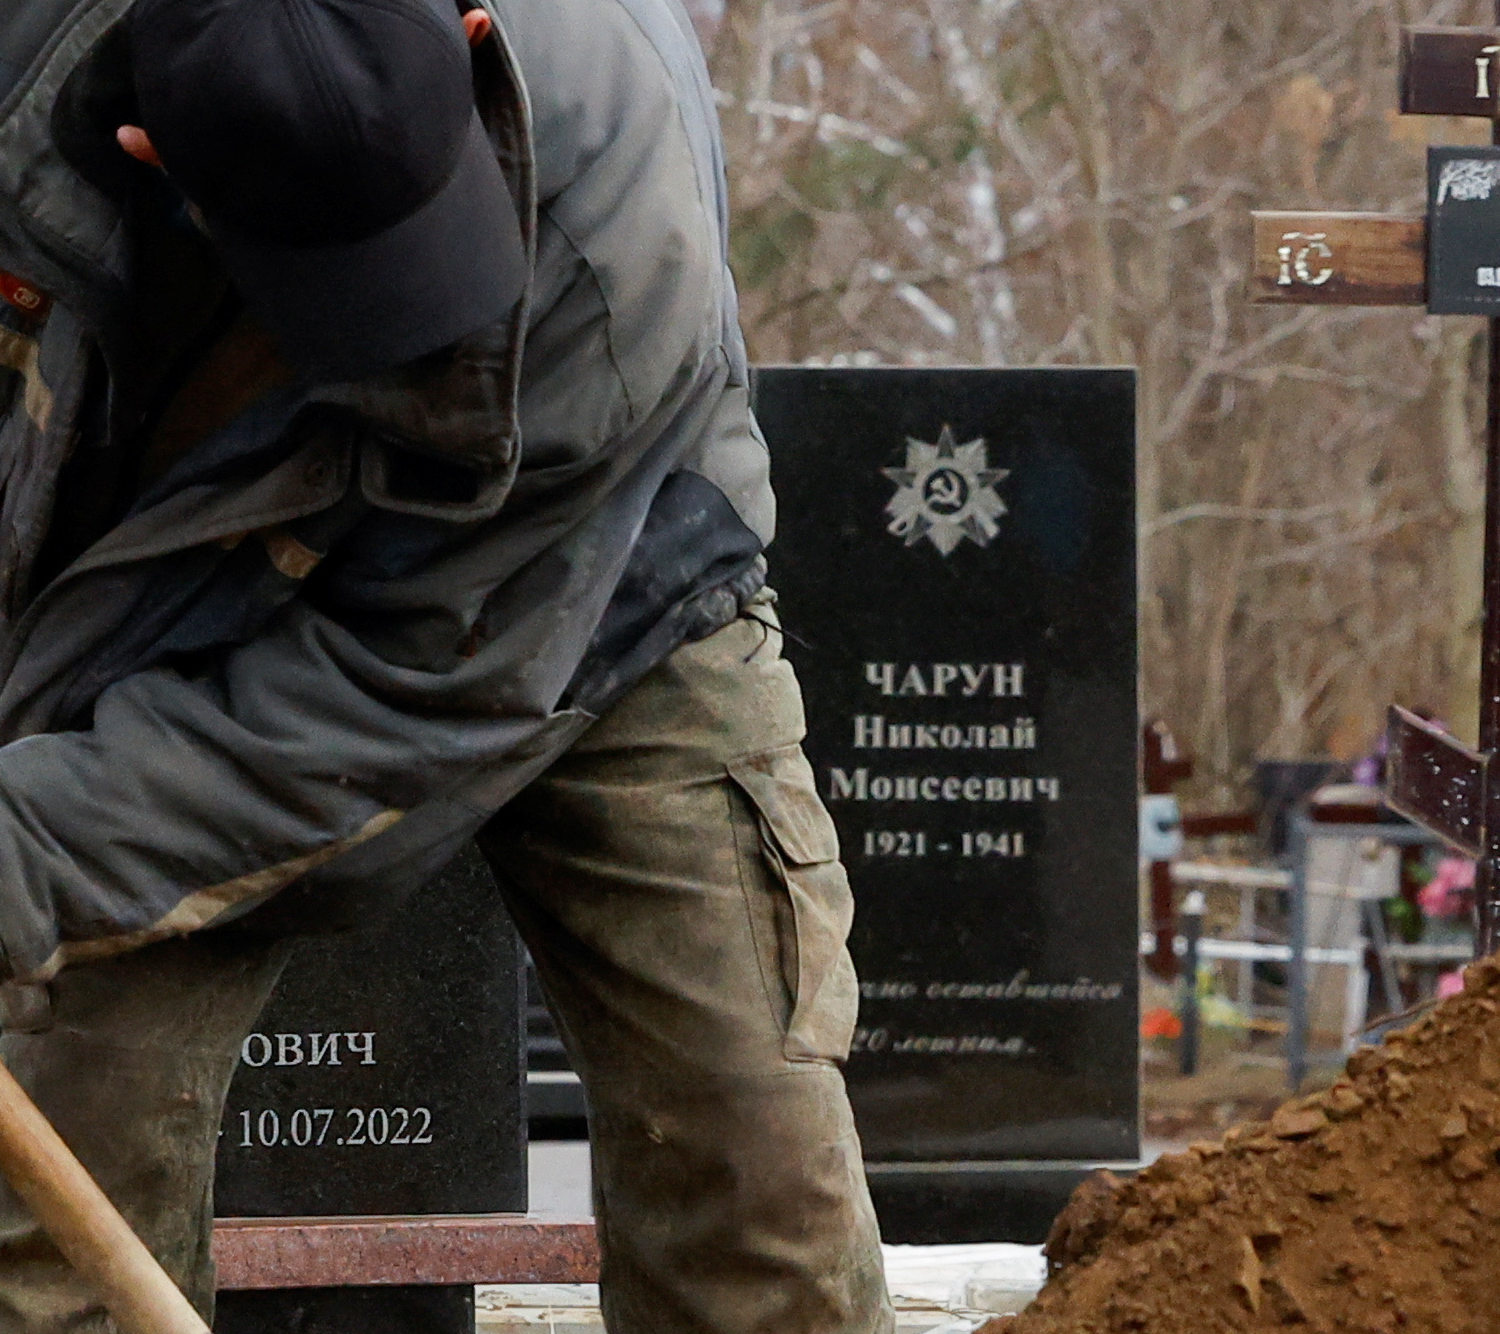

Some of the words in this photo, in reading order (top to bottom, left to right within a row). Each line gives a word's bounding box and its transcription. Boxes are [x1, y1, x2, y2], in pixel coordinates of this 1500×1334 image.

[866, 662, 1023, 697] ЧАРУН
[854, 715, 1036, 749] Николай
[830, 767, 1060, 802] Моисеевич
[864, 831, 926, 857] 1921
[962, 831, 1024, 857] 1941
[239, 1107, 433, 1147] 10.07.2022
